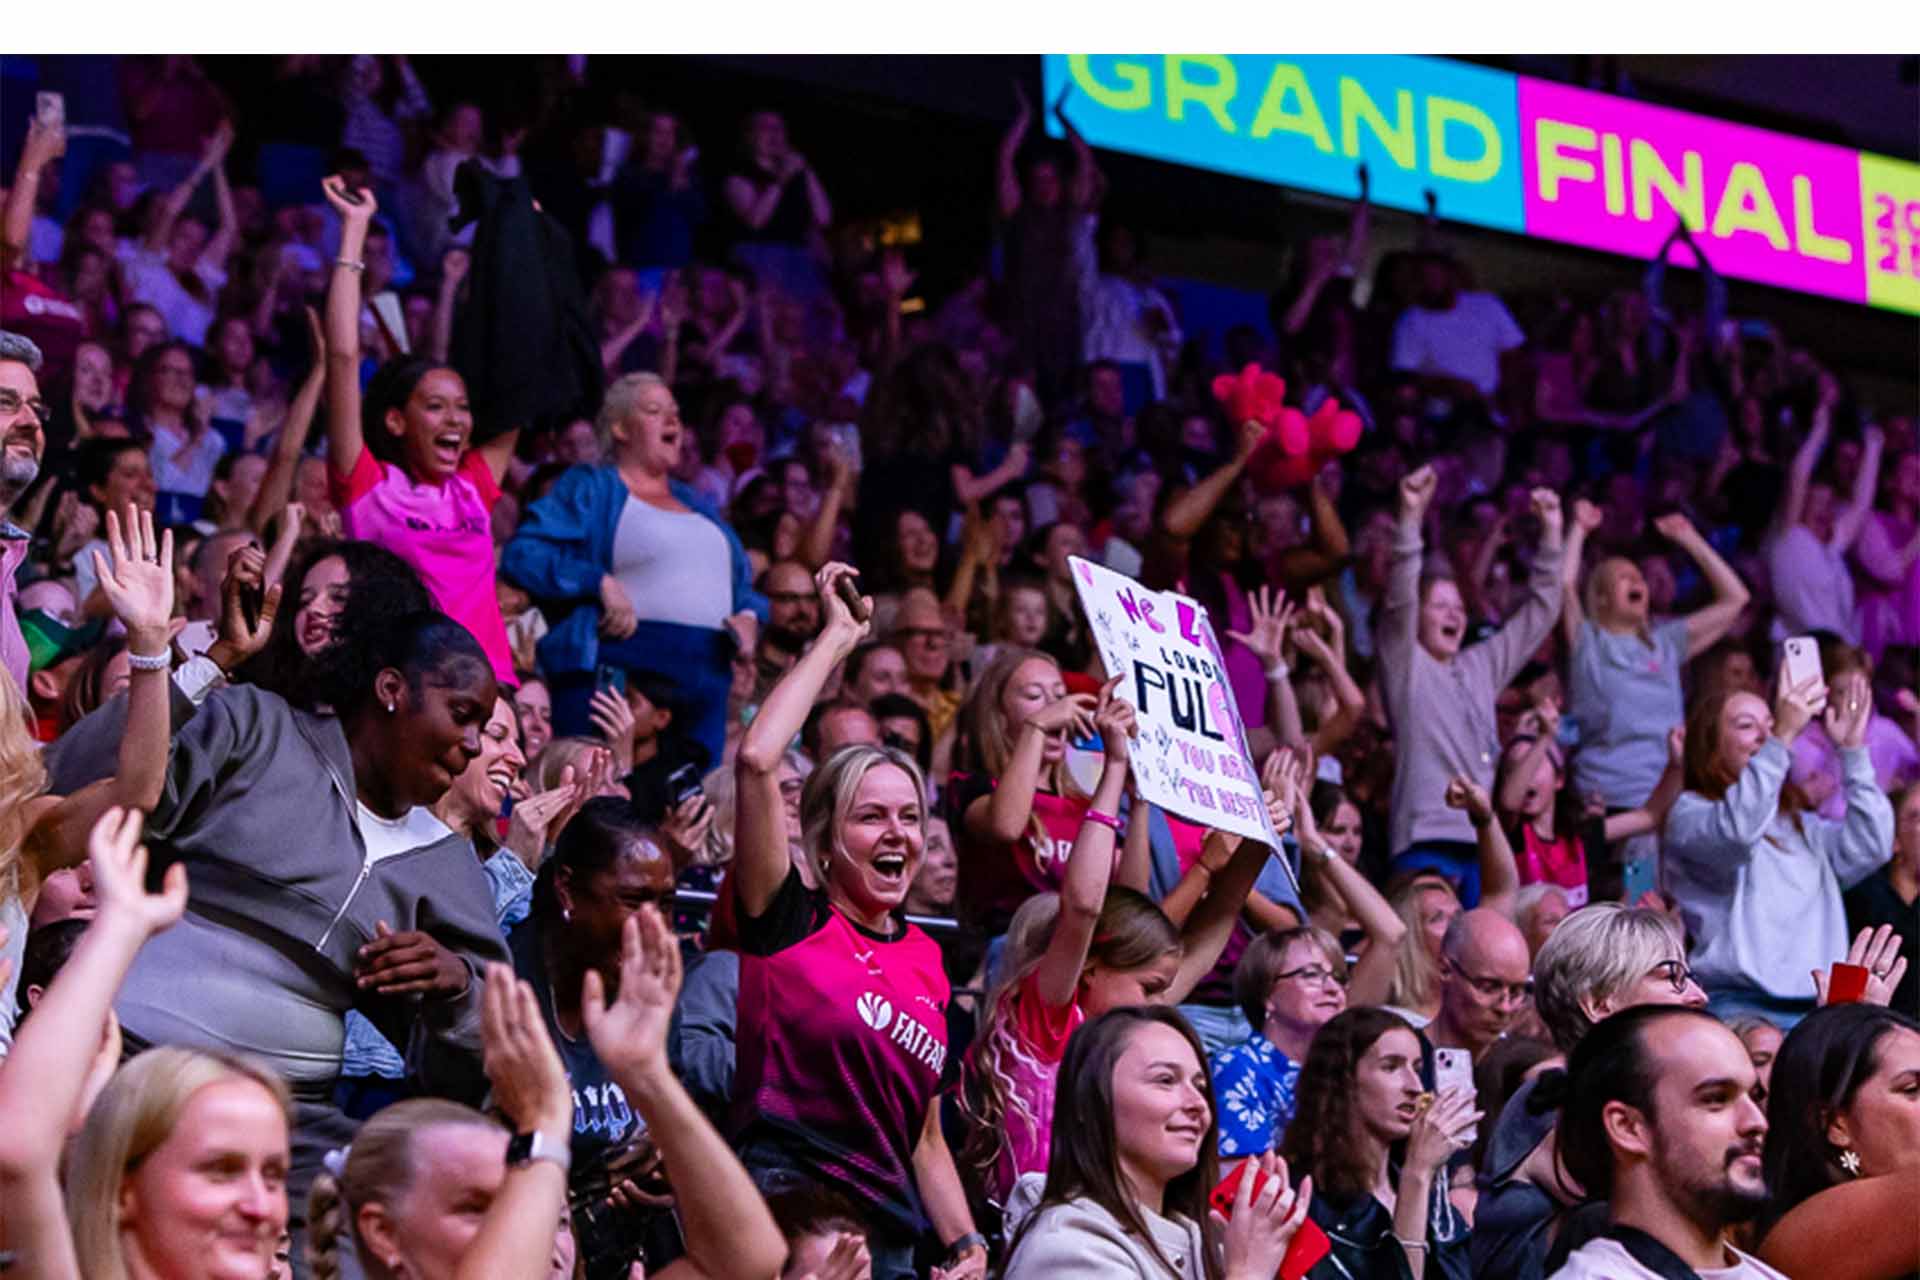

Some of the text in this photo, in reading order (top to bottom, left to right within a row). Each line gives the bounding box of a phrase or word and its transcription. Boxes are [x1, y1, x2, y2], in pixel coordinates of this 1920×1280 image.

[1068, 54, 1854, 265] GRAND FINAL
[1176, 738, 1215, 774] YOU
